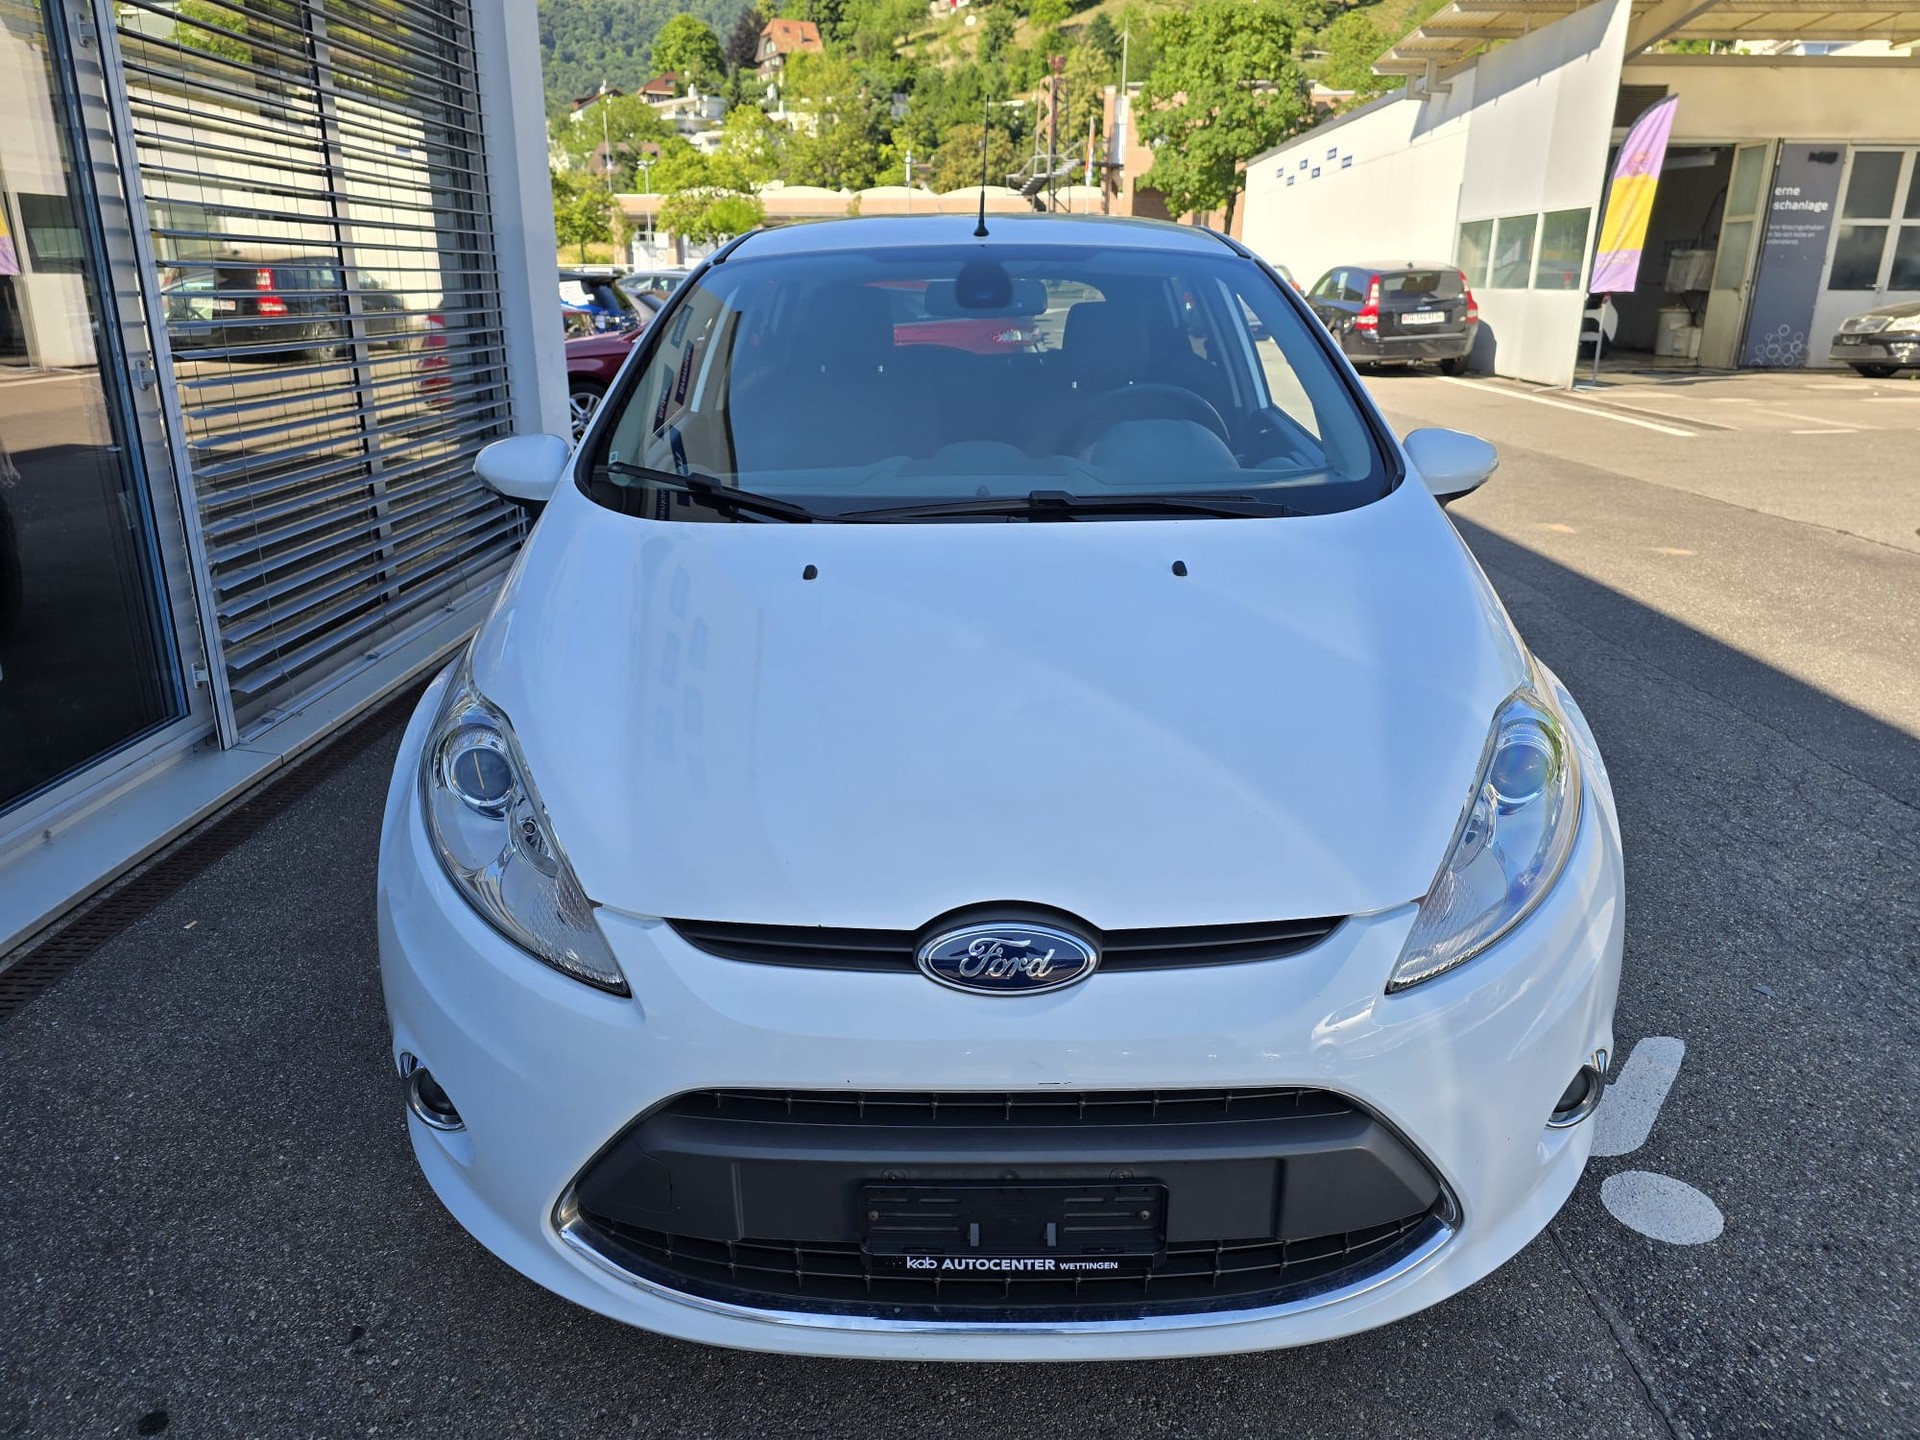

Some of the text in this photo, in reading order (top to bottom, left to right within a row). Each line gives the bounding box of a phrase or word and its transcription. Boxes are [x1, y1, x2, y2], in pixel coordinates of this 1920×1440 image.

[959, 937, 1056, 979] Ford
[906, 1256, 1118, 1271] kab AUTOCENTER WETTINGEN
